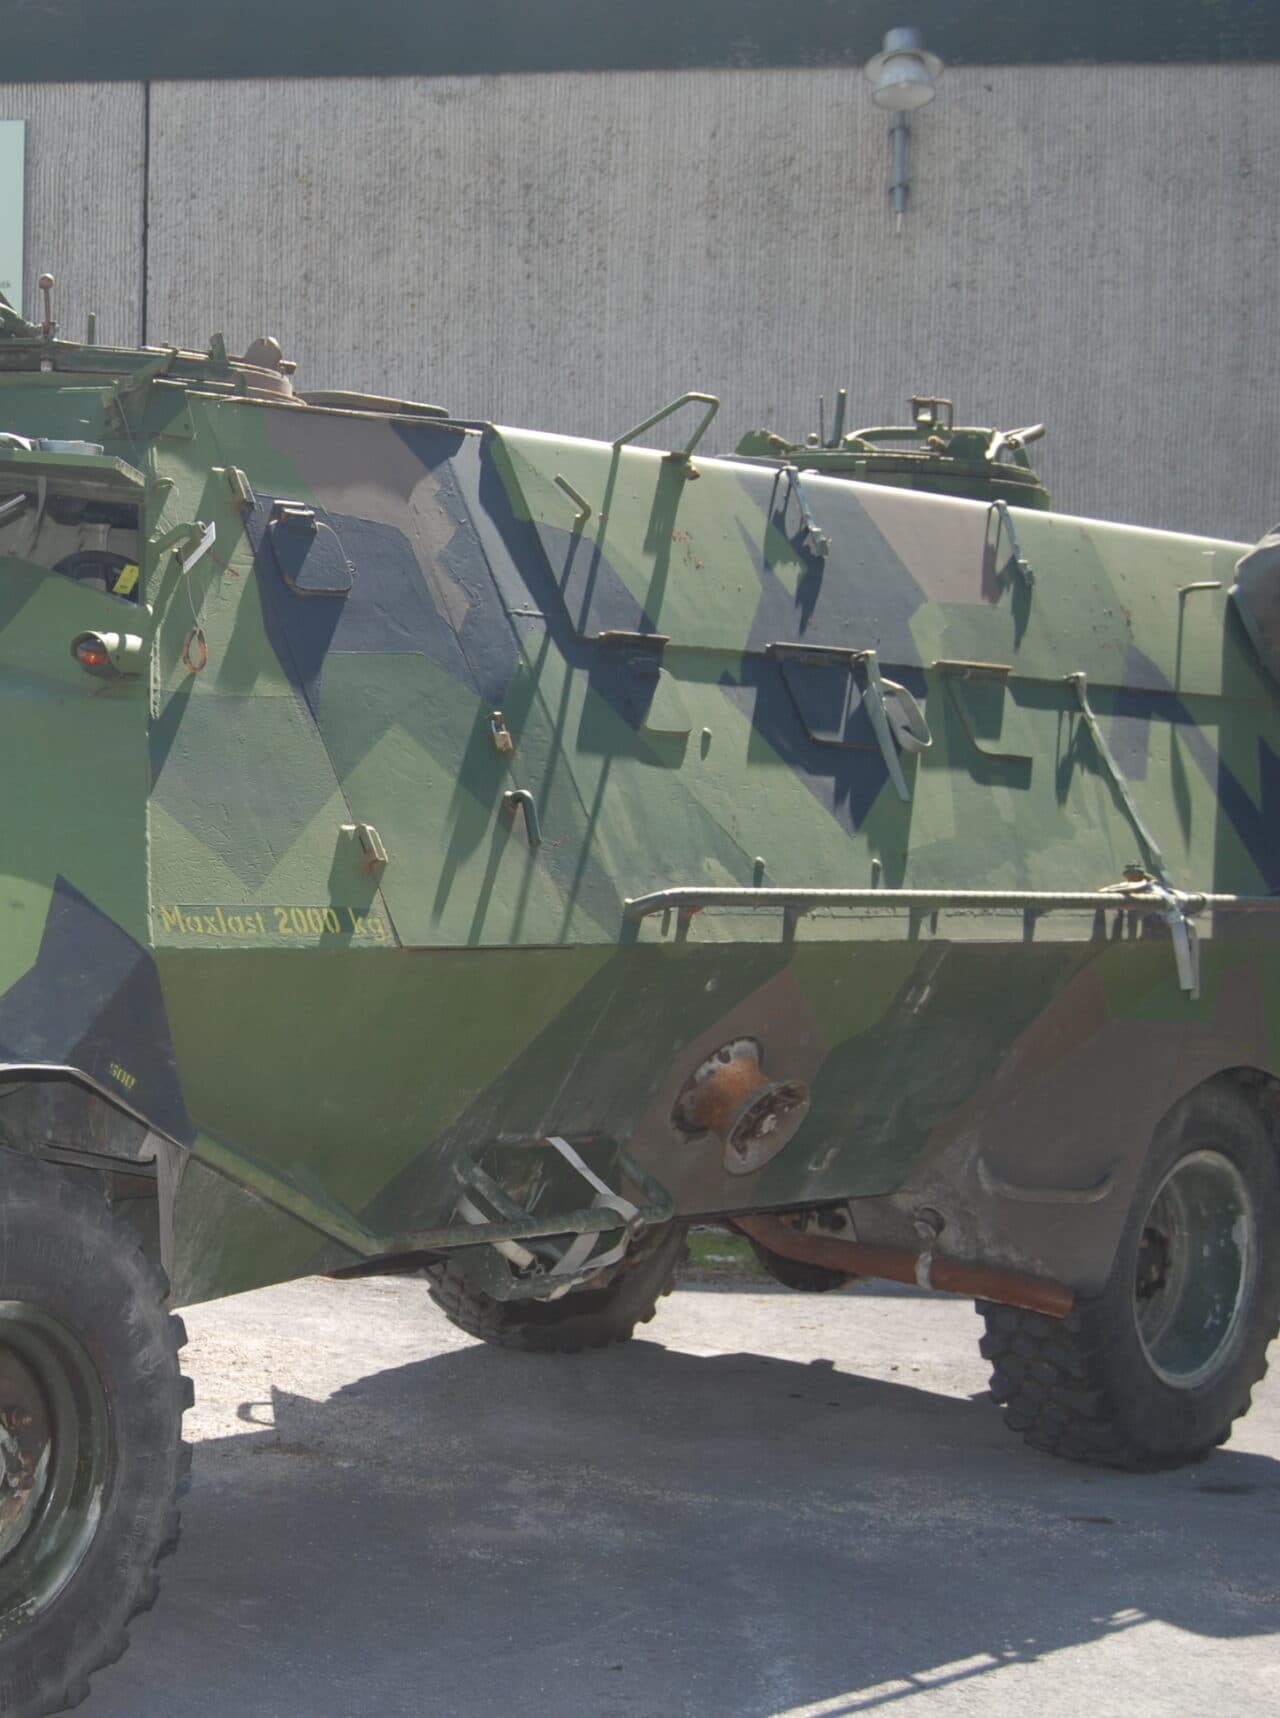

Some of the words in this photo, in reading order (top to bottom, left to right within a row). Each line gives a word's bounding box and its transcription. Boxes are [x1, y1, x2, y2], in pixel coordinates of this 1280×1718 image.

[160, 904, 266, 935] Maxlast
[274, 906, 341, 935] 2000
[348, 907, 391, 942] kg
